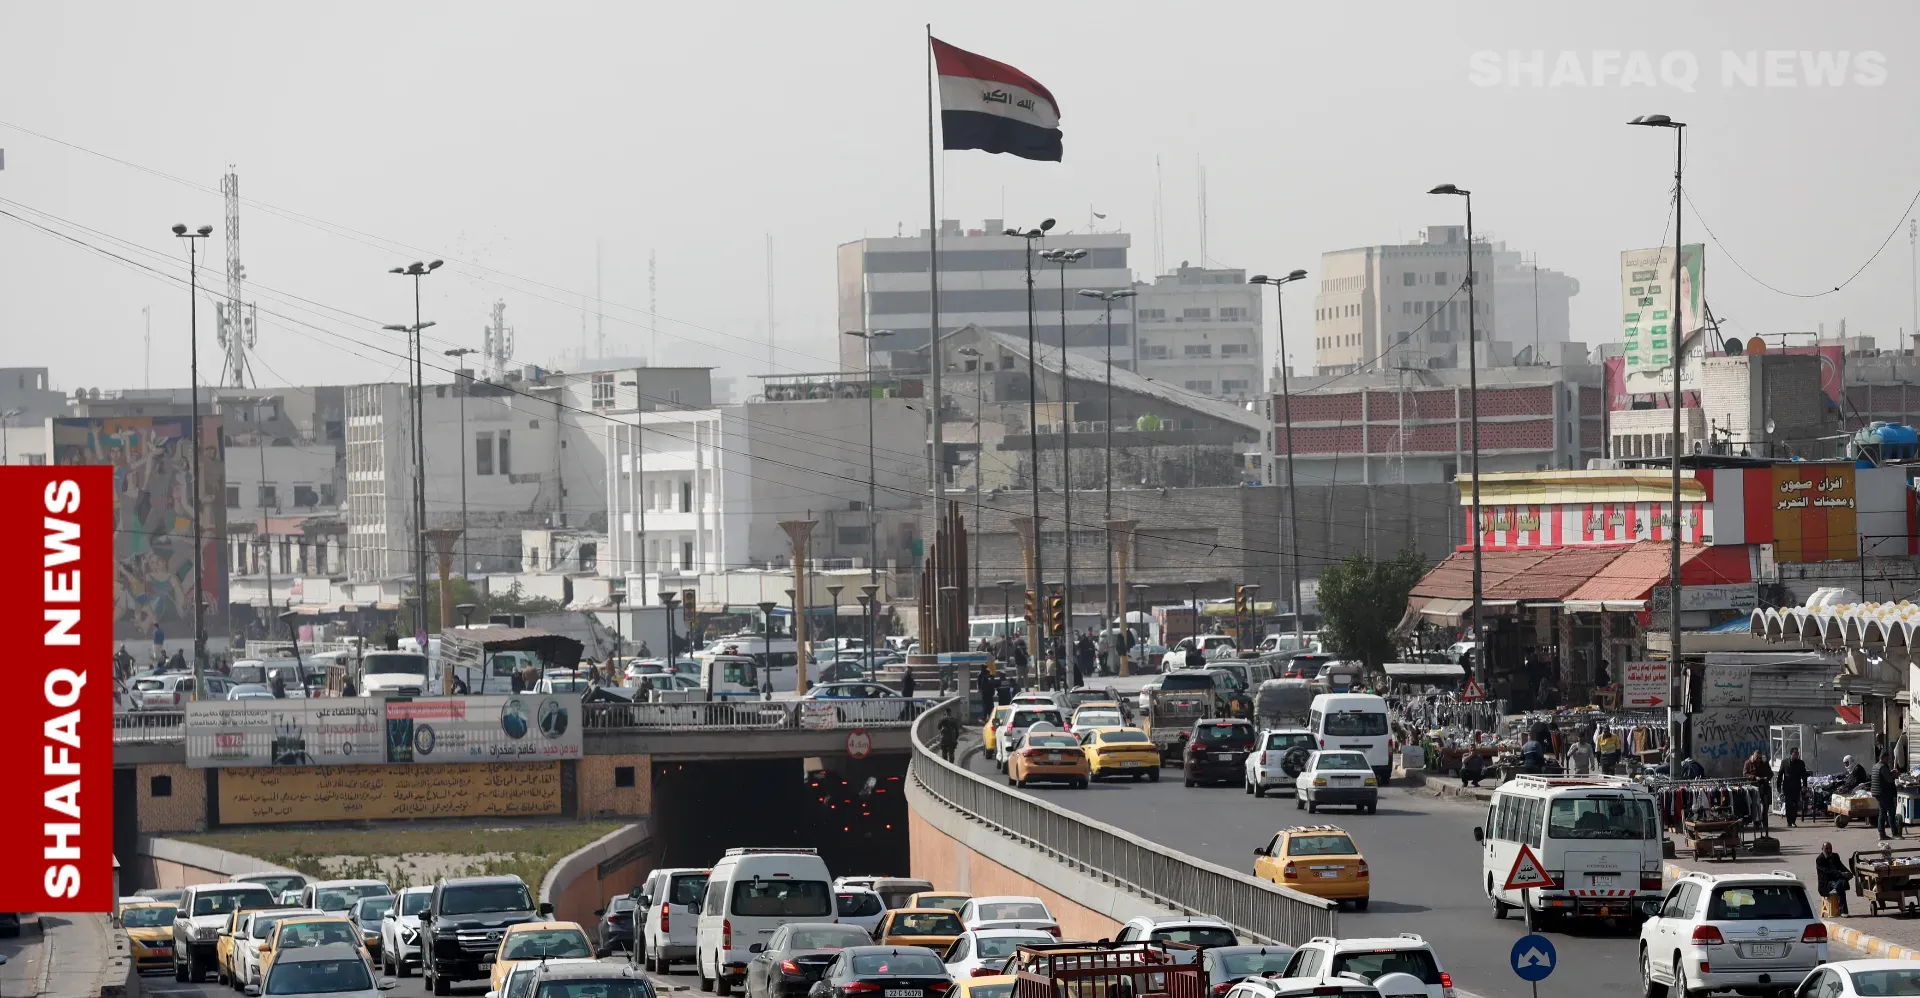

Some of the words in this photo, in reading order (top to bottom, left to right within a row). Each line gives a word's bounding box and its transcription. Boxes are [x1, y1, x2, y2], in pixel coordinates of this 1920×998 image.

[983, 89, 1012, 104] اكبر
[1016, 99, 1036, 111] الله
[1780, 479, 1813, 492] صمون
[1776, 495, 1809, 509] التحرير
[1813, 495, 1855, 508] ومعجنات
[1517, 872, 1539, 881] السرعة
